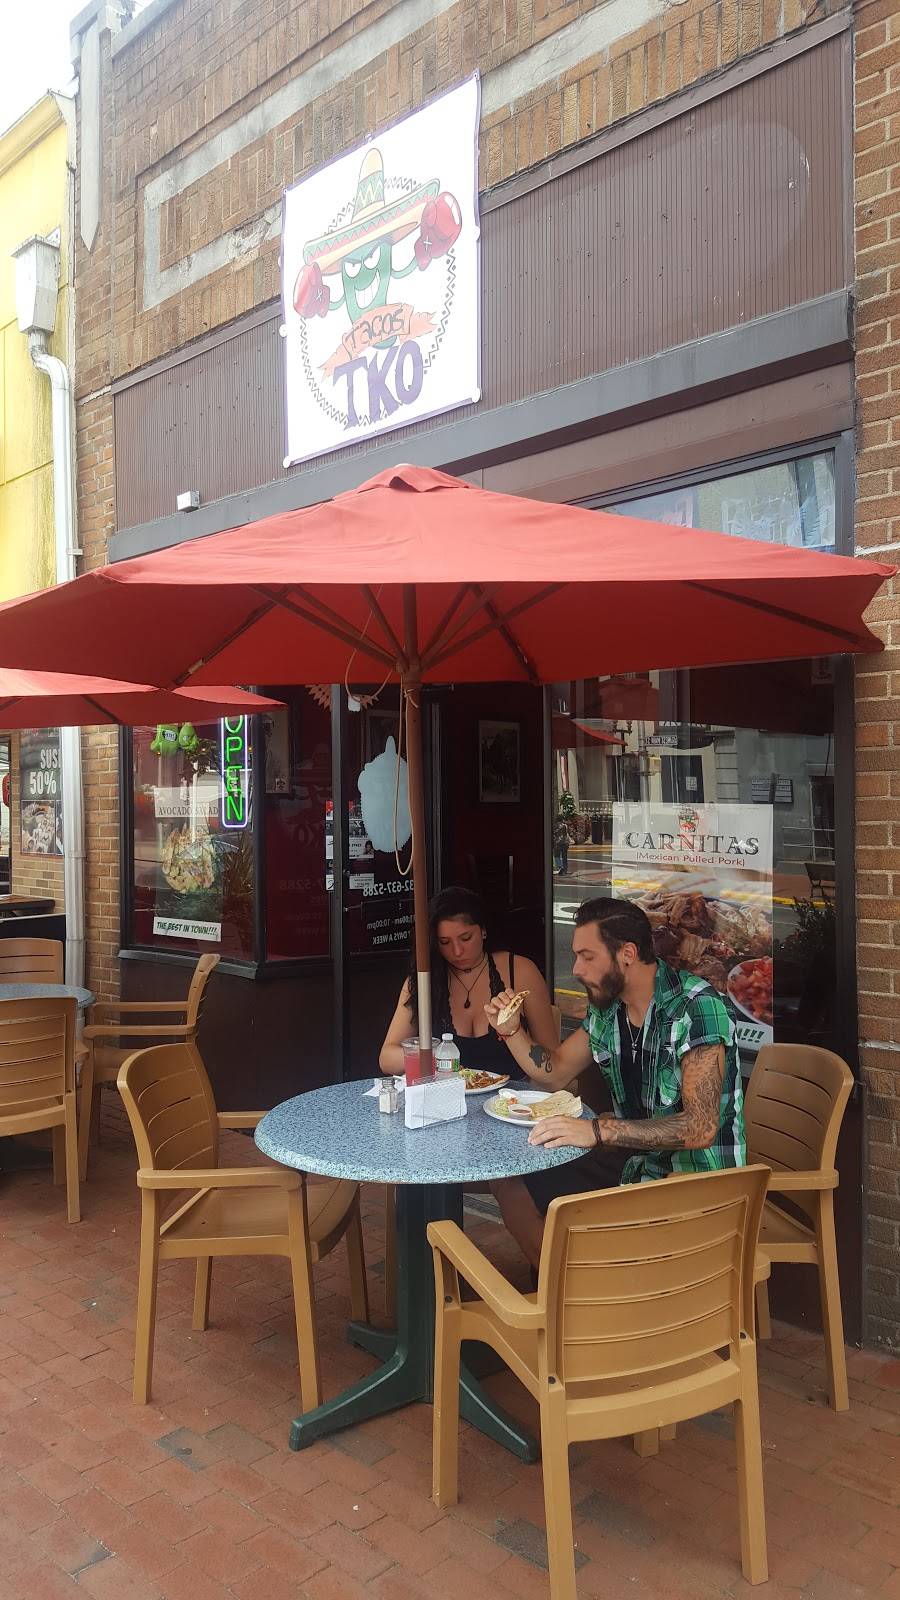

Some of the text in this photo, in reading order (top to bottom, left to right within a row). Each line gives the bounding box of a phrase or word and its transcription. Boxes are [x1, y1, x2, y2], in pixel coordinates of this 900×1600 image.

[333, 340, 424, 431] TKO
[30, 771, 57, 795] 50%
[159, 806, 192, 816] AVOCADO
[625, 832, 760, 856] CARNITAS
[683, 855, 714, 864] Pulled
[156, 921, 167, 930] THE
[168, 922, 183, 932] BEST
[183, 924, 190, 933] IN
